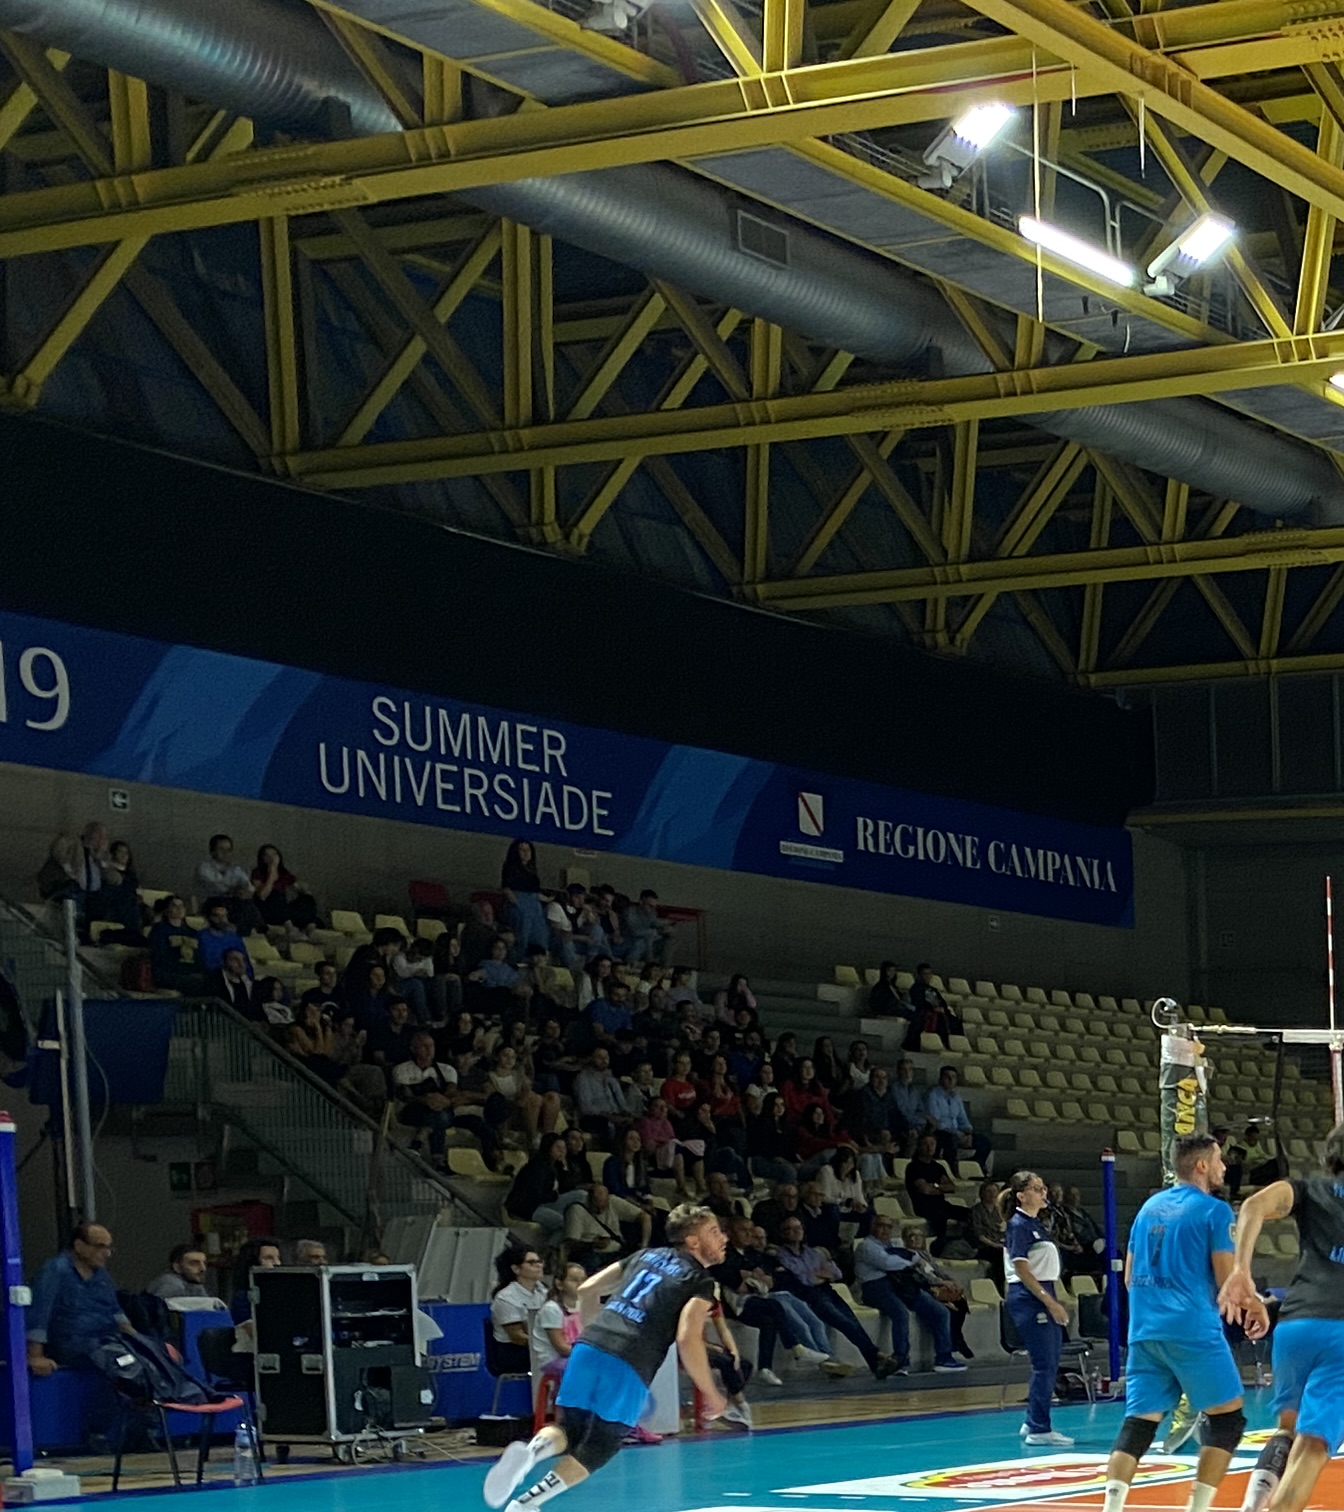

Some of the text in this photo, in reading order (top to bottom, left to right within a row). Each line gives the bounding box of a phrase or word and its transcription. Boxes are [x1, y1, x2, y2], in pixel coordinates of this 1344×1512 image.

[371, 696, 567, 777] SUMMER
[318, 742, 614, 836] UNIVERSIADE
[855, 816, 1117, 892] REGIONE CAMPANIA
[1174, 1078, 1198, 1135] ANCA
[621, 1269, 663, 1303] 17
